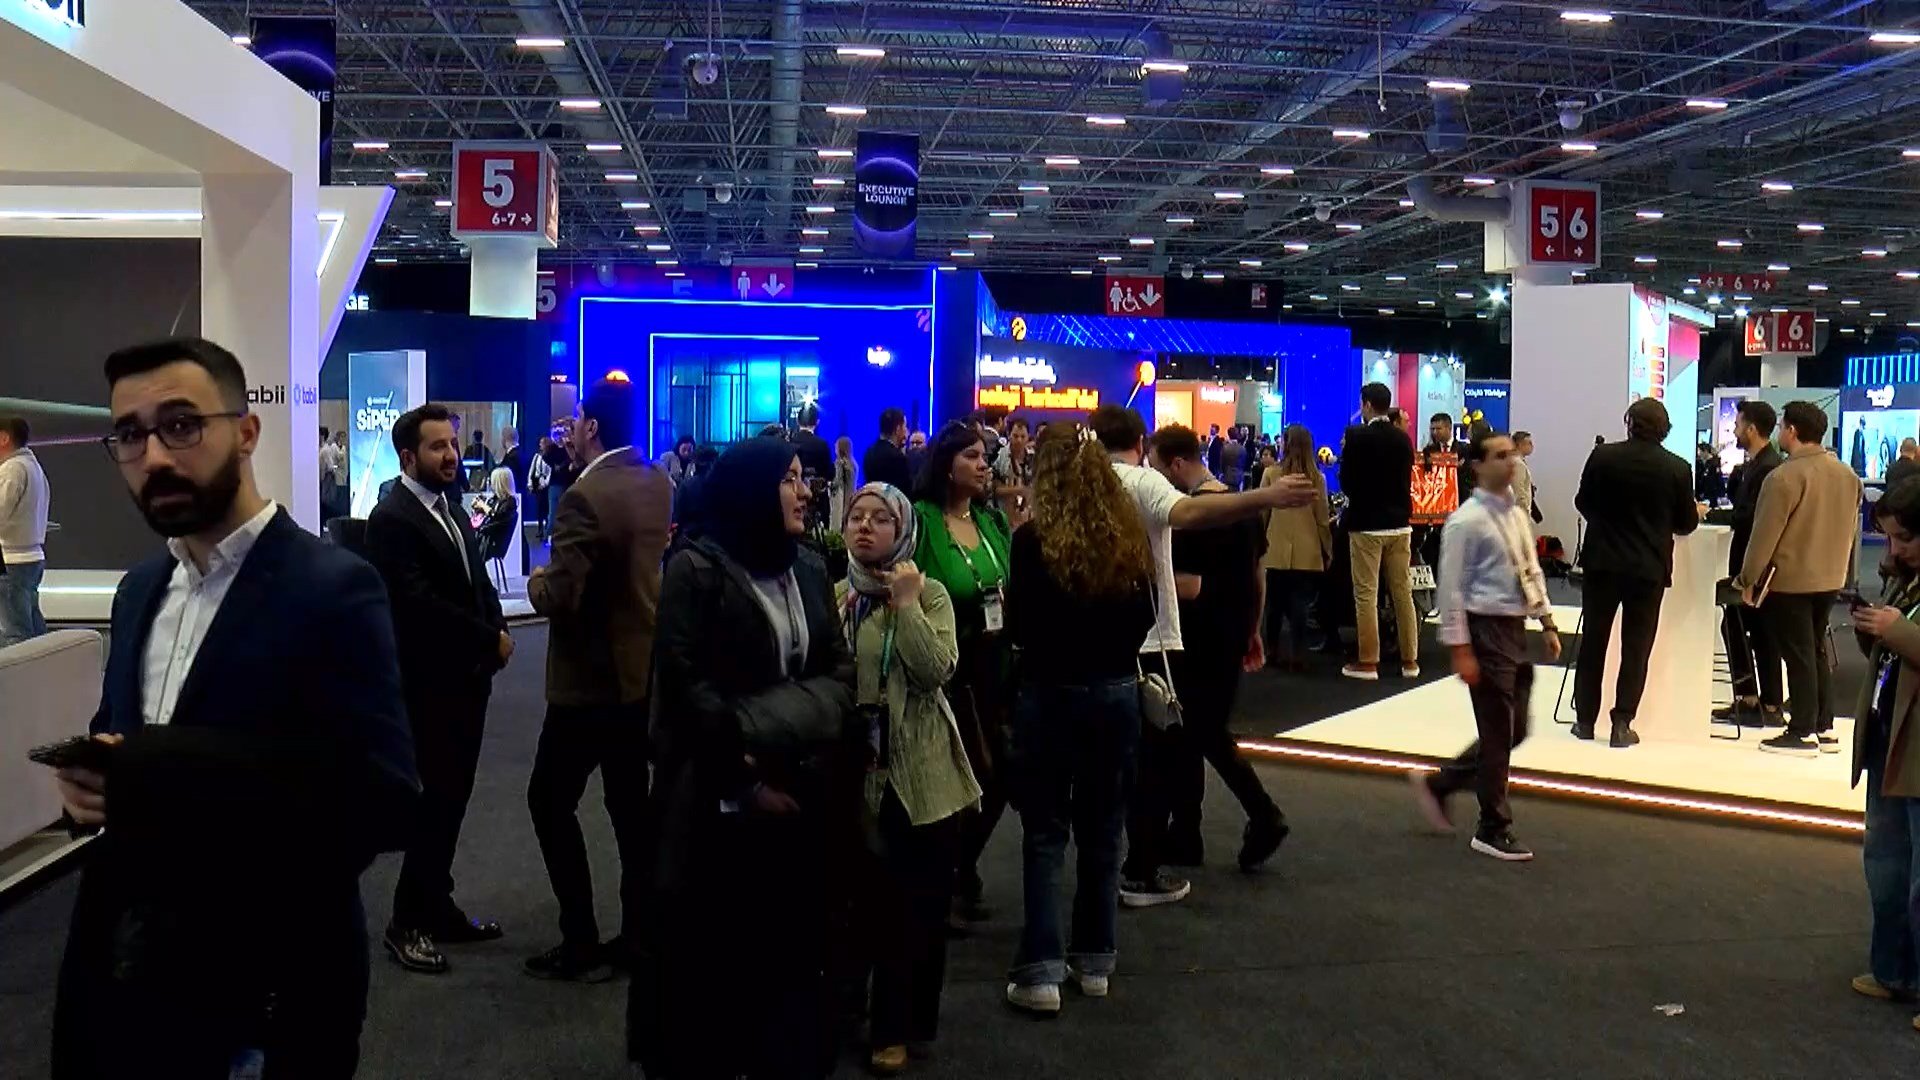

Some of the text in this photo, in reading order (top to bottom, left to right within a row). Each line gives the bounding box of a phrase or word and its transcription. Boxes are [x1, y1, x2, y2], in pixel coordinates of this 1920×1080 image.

[309, 90, 331, 102] VE
[482, 158, 515, 208] 5
[858, 183, 915, 197] EXECUTIVE
[865, 192, 907, 206] LOUNGE
[1540, 204, 1589, 240] 5 6
[1733, 275, 1743, 291] 6
[345, 294, 370, 311] GE
[536, 278, 557, 313] 5
[1753, 315, 1765, 341] 6
[1788, 314, 1804, 341] 6
[247, 385, 285, 405] abii
